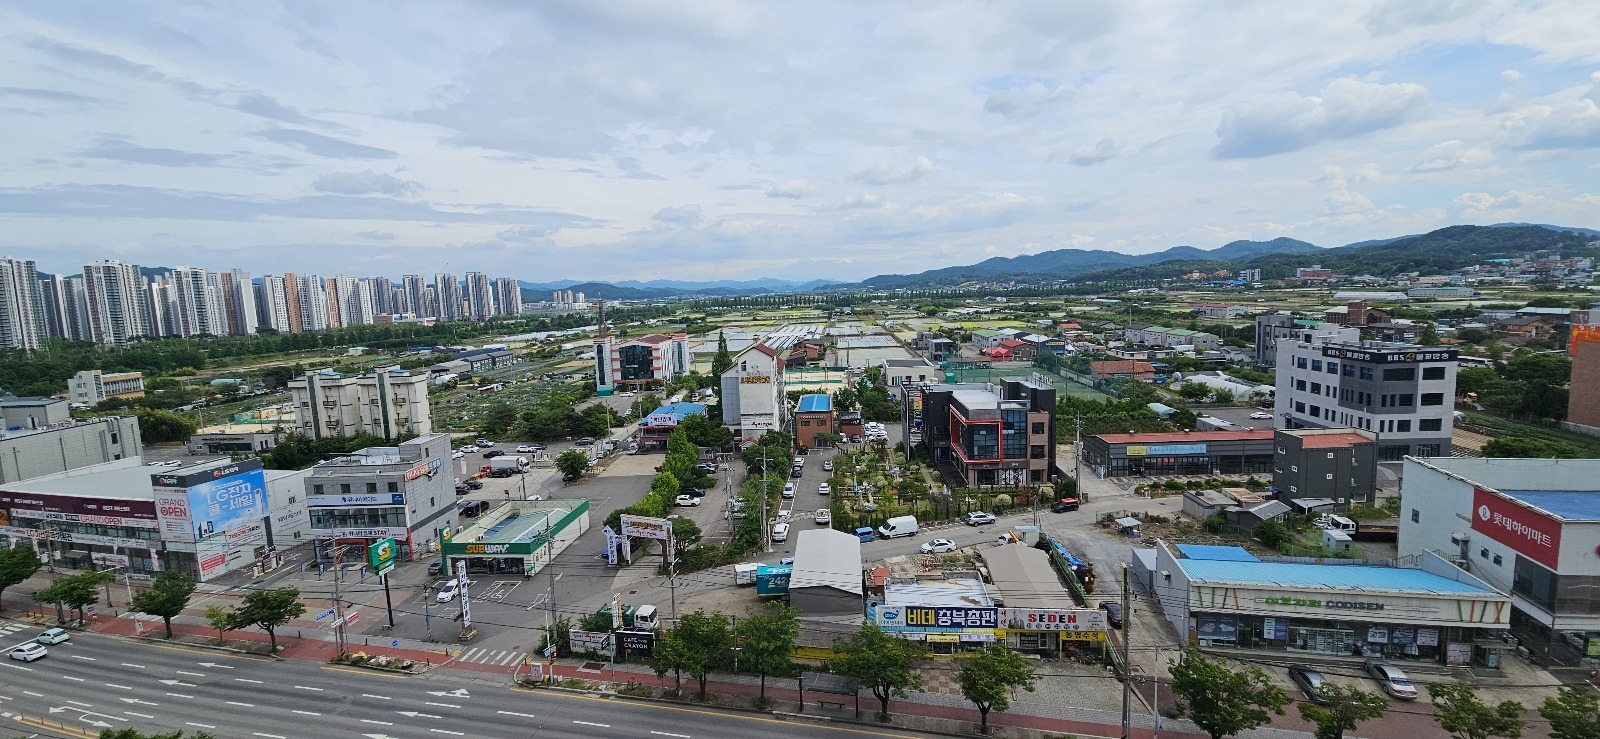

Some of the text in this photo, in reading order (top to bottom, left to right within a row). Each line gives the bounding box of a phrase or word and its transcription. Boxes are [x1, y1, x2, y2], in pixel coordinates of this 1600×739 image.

[1346, 351, 1371, 361] 불교방송
[1416, 353, 1449, 361] 불교방송
[207, 483, 252, 505] LG전자
[159, 498, 185, 507] GRAND
[161, 507, 187, 518] OPEN
[80, 515, 104, 524] GRAND
[104, 517, 122, 526] OPEN
[373, 528, 388, 536] STAY
[1493, 511, 1552, 548] 롯데하이마트
[466, 543, 509, 554] SUBWAY
[1326, 600, 1384, 611] CODISEN
[907, 608, 935, 625] 비데
[1027, 613, 1077, 624] SEDEN
